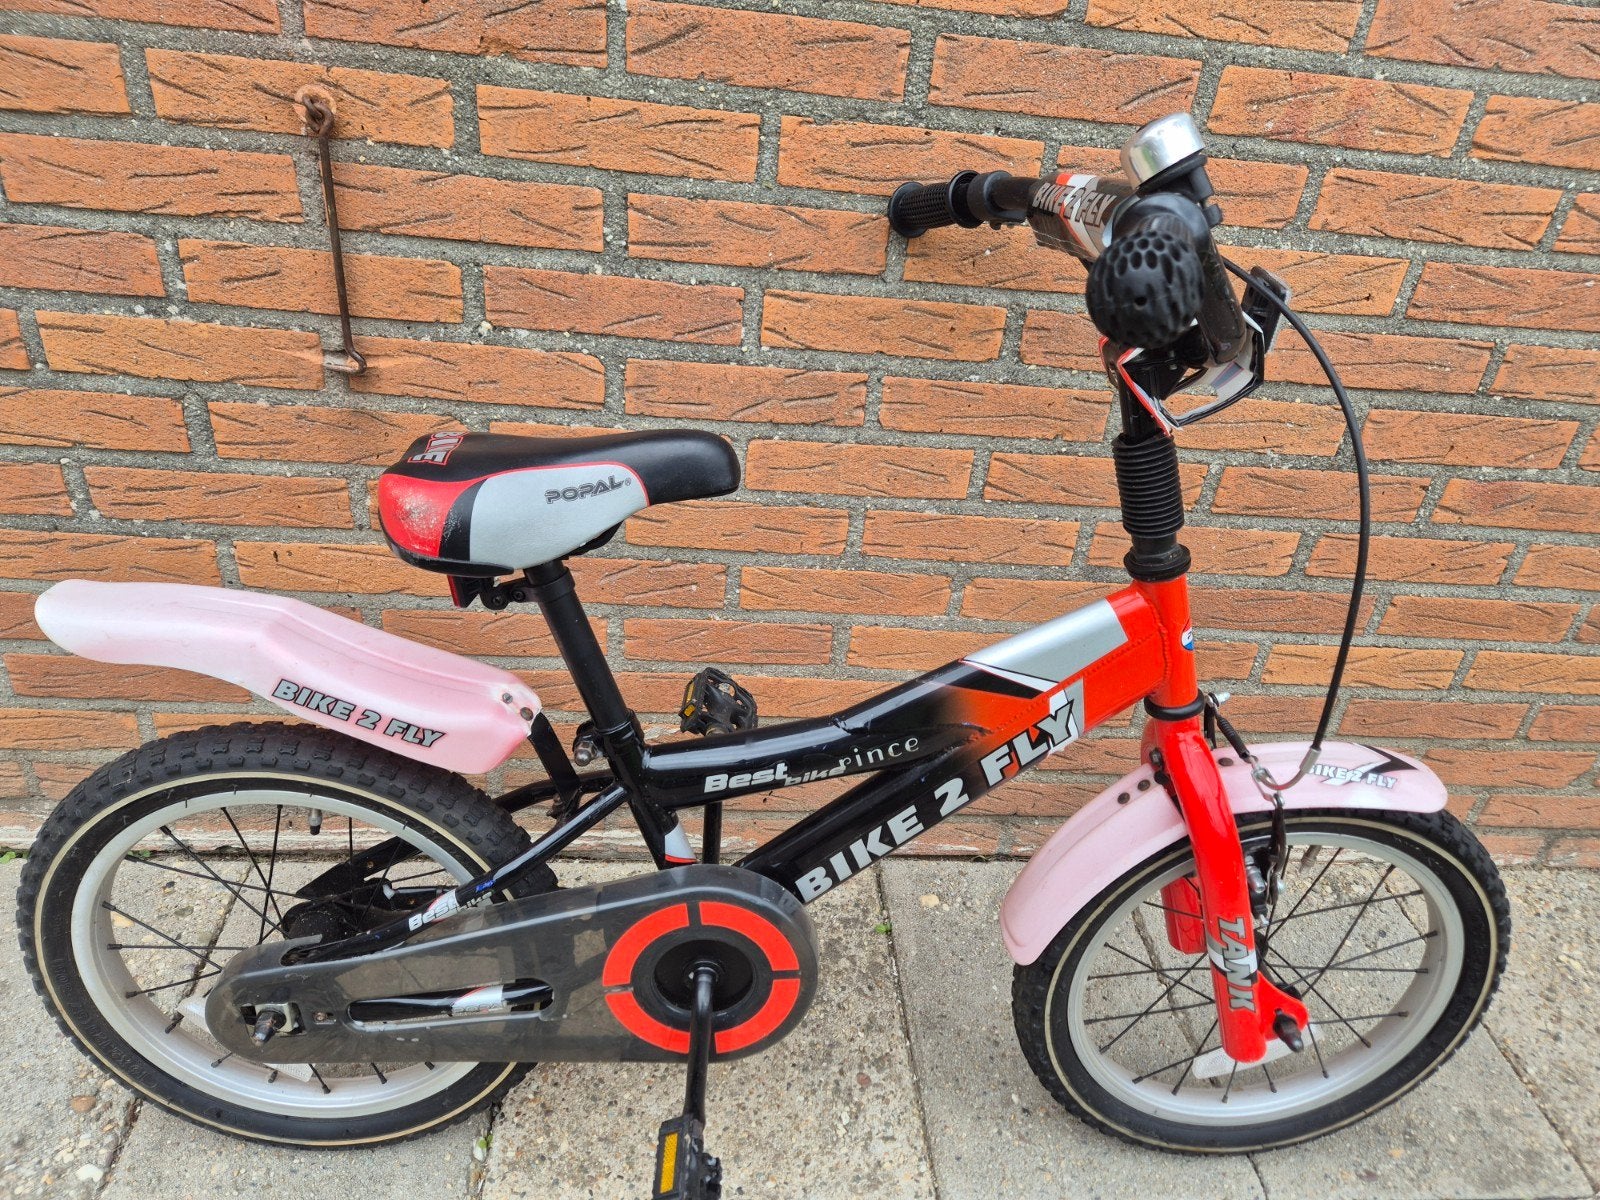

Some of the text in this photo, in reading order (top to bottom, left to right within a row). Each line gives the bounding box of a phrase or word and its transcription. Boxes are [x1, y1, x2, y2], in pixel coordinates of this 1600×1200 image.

[1031, 182, 1118, 227] BIKE 2 FLY
[271, 678, 446, 747] BIKE 2 FLY
[704, 762, 788, 793] Best
[794, 699, 1075, 902] BIKE 2 FLY
[1366, 772, 1398, 789] FLY
[1217, 916, 1256, 1014] TANK
